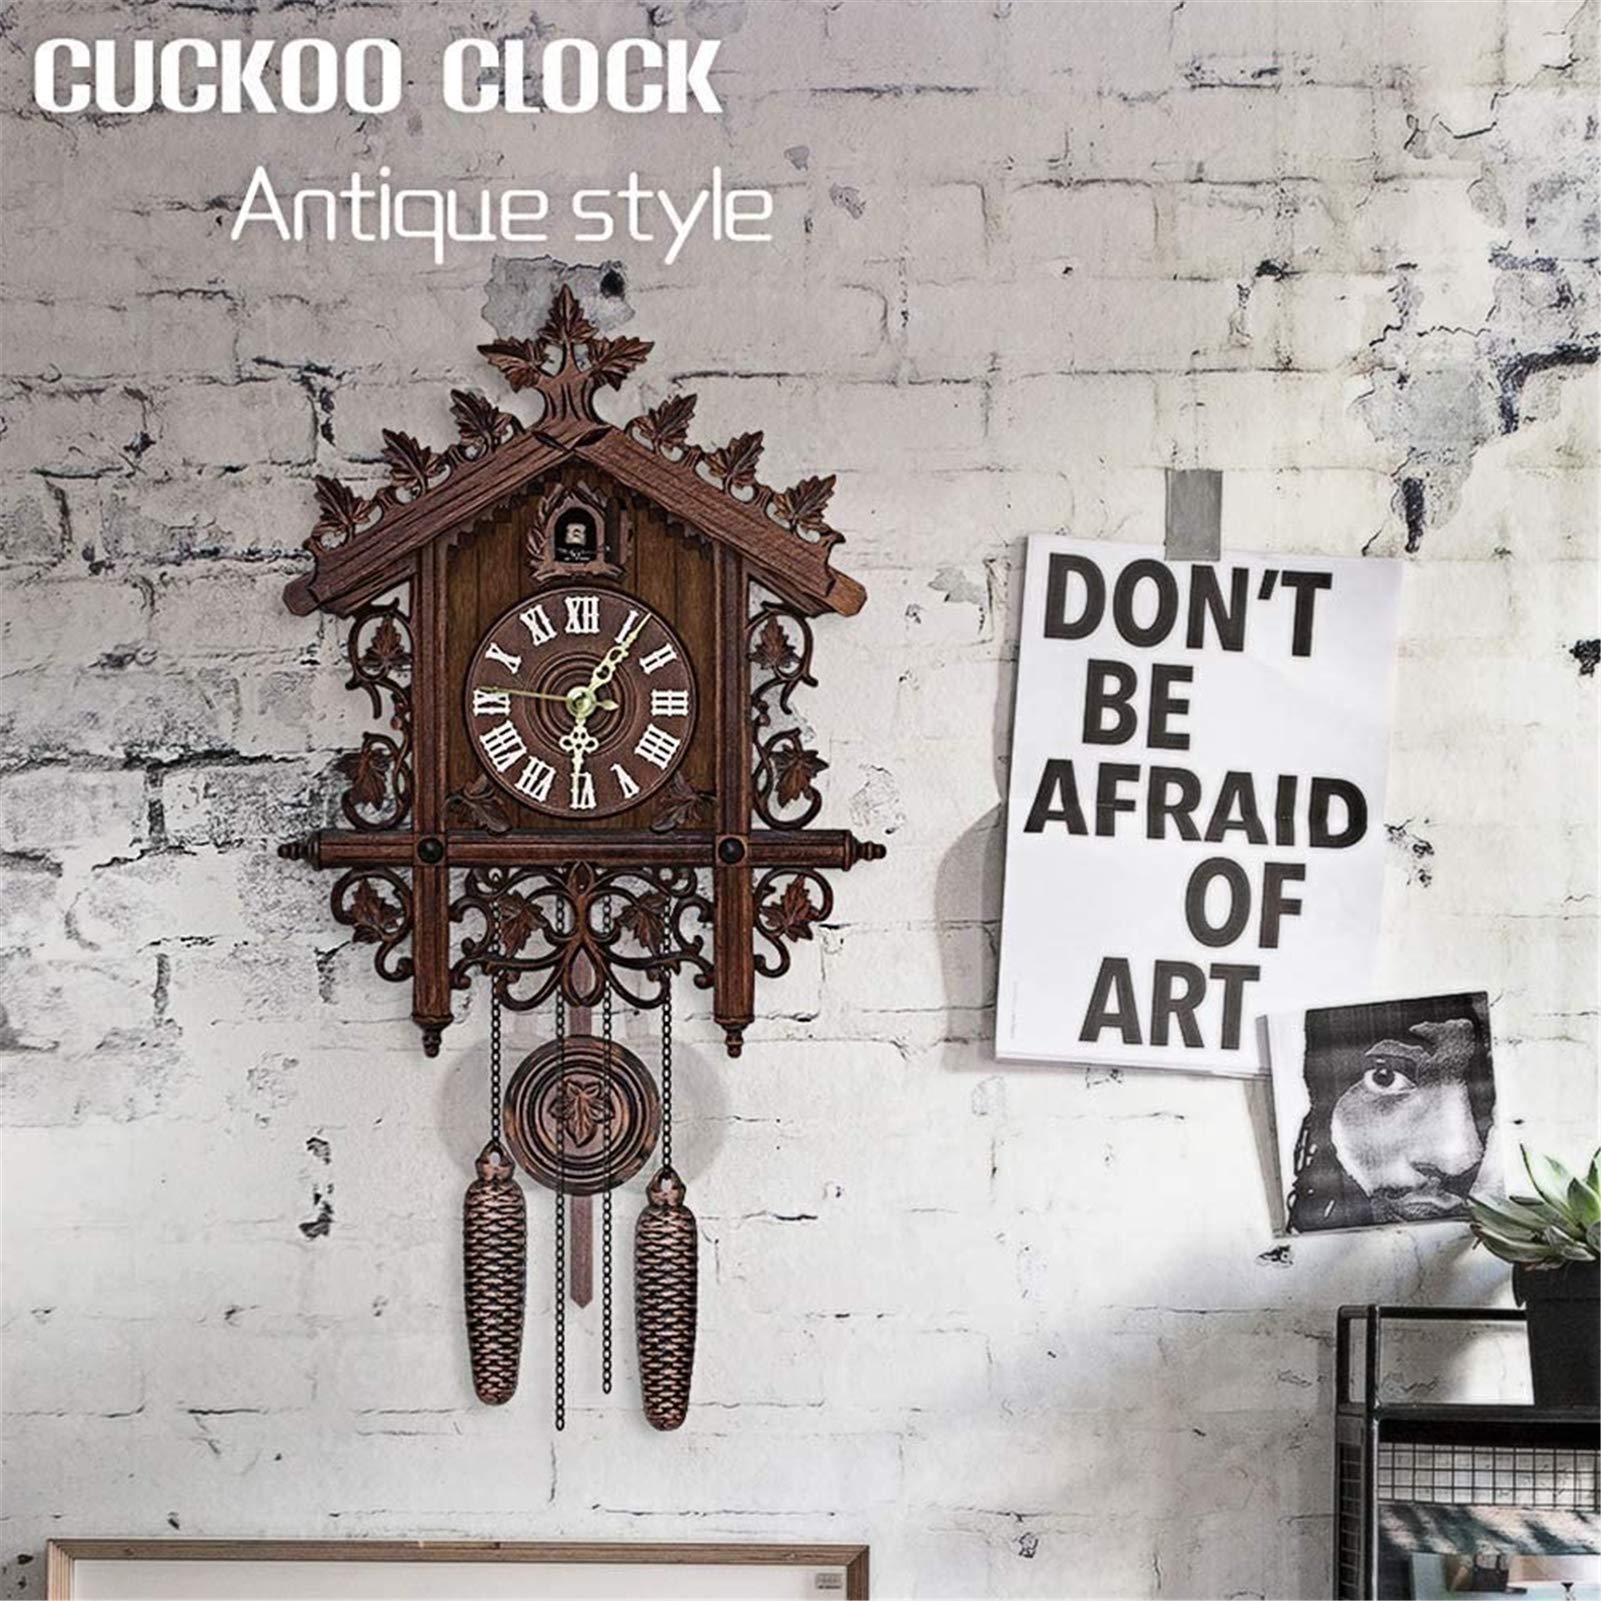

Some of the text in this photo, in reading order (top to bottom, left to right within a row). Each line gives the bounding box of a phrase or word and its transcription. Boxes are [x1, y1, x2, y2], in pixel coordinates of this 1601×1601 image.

[519, 604, 558, 646] XI
[564, 596, 600, 634] XII
[1043, 552, 1333, 657] DON'T
[614, 610, 640, 644] I
[485, 642, 522, 674] X
[639, 643, 678, 675] II
[473, 688, 511, 716] IX
[651, 689, 689, 716] III
[1082, 658, 1194, 751] BE
[479, 719, 527, 773] VIII
[634, 723, 681, 770] IIII
[514, 756, 556, 803] VII
[570, 772, 597, 810] VI
[610, 763, 640, 799] V
[1023, 758, 1368, 849] AFRAID
[1184, 856, 1306, 949] OF
[1078, 956, 1261, 1051] ART
